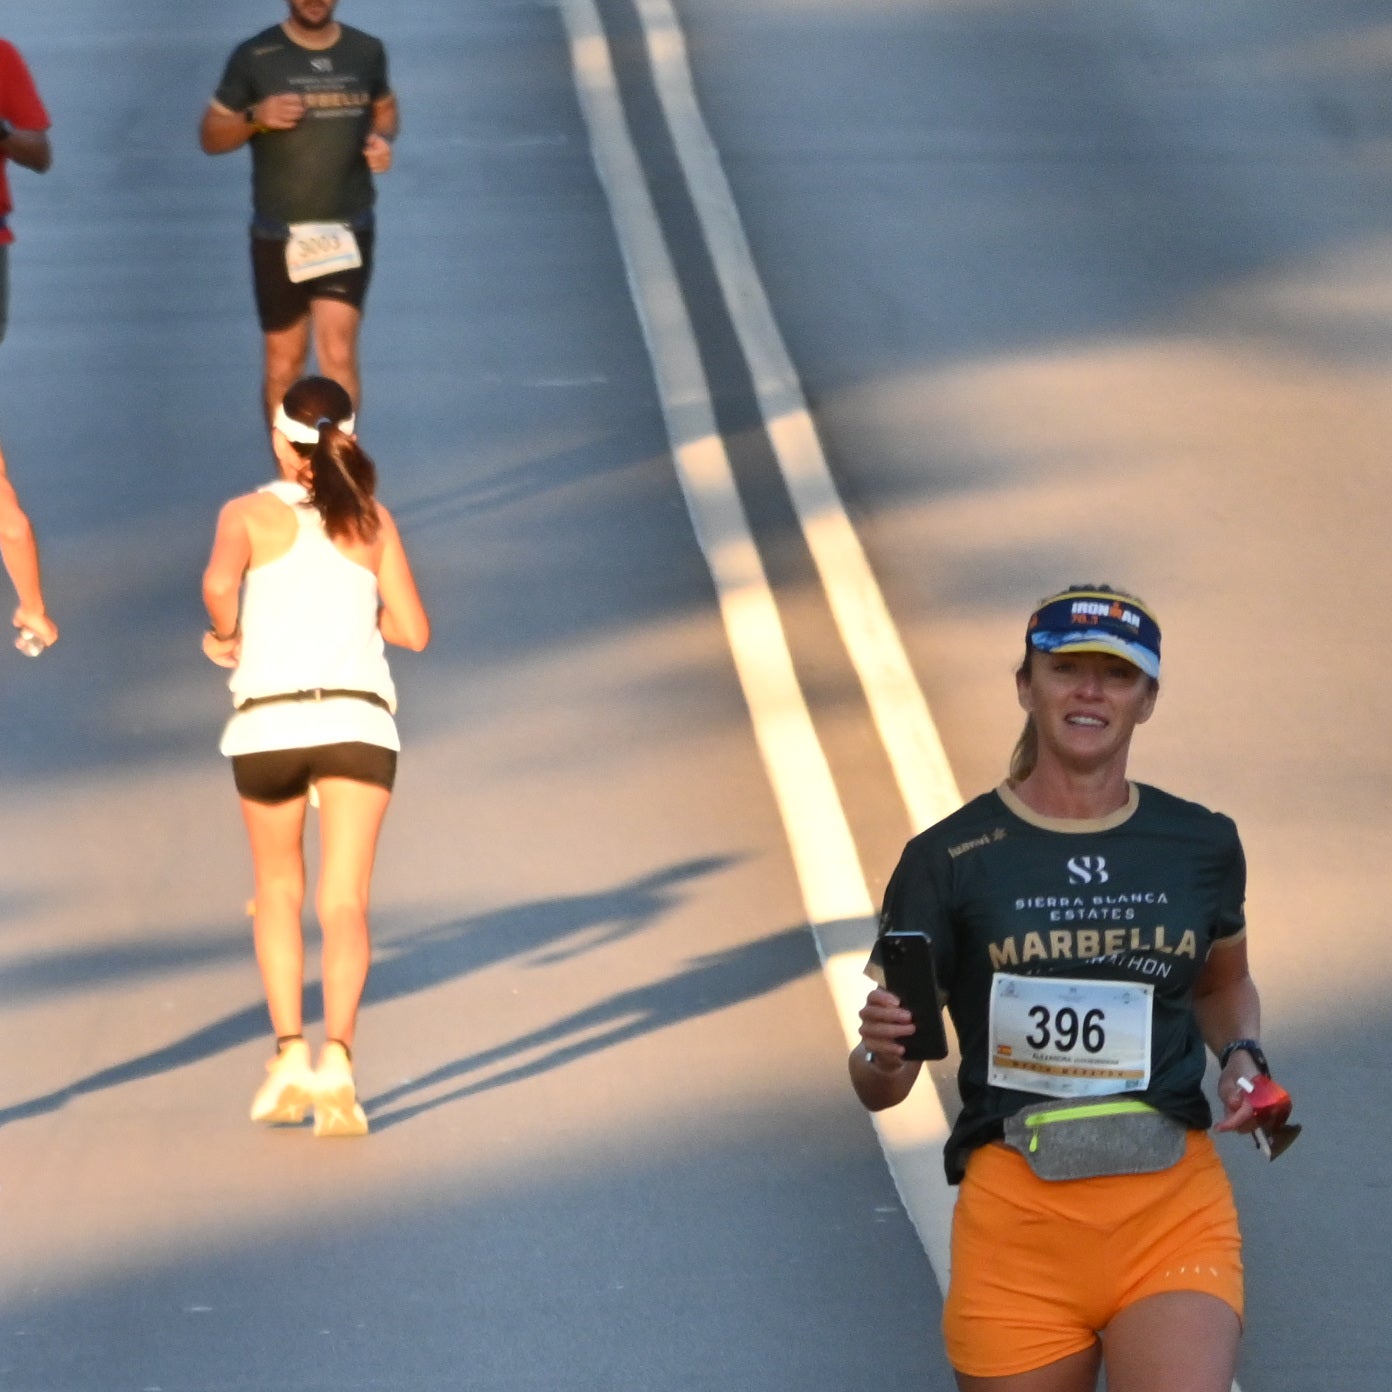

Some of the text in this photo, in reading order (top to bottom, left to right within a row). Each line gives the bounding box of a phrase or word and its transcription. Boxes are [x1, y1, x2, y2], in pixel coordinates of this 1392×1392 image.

[1016, 892, 1169, 911] SIERRA BLANCA
[1050, 907, 1136, 922] ESTATES
[988, 925, 1197, 971] MARBELLA
[1026, 1005, 1106, 1054] 396
